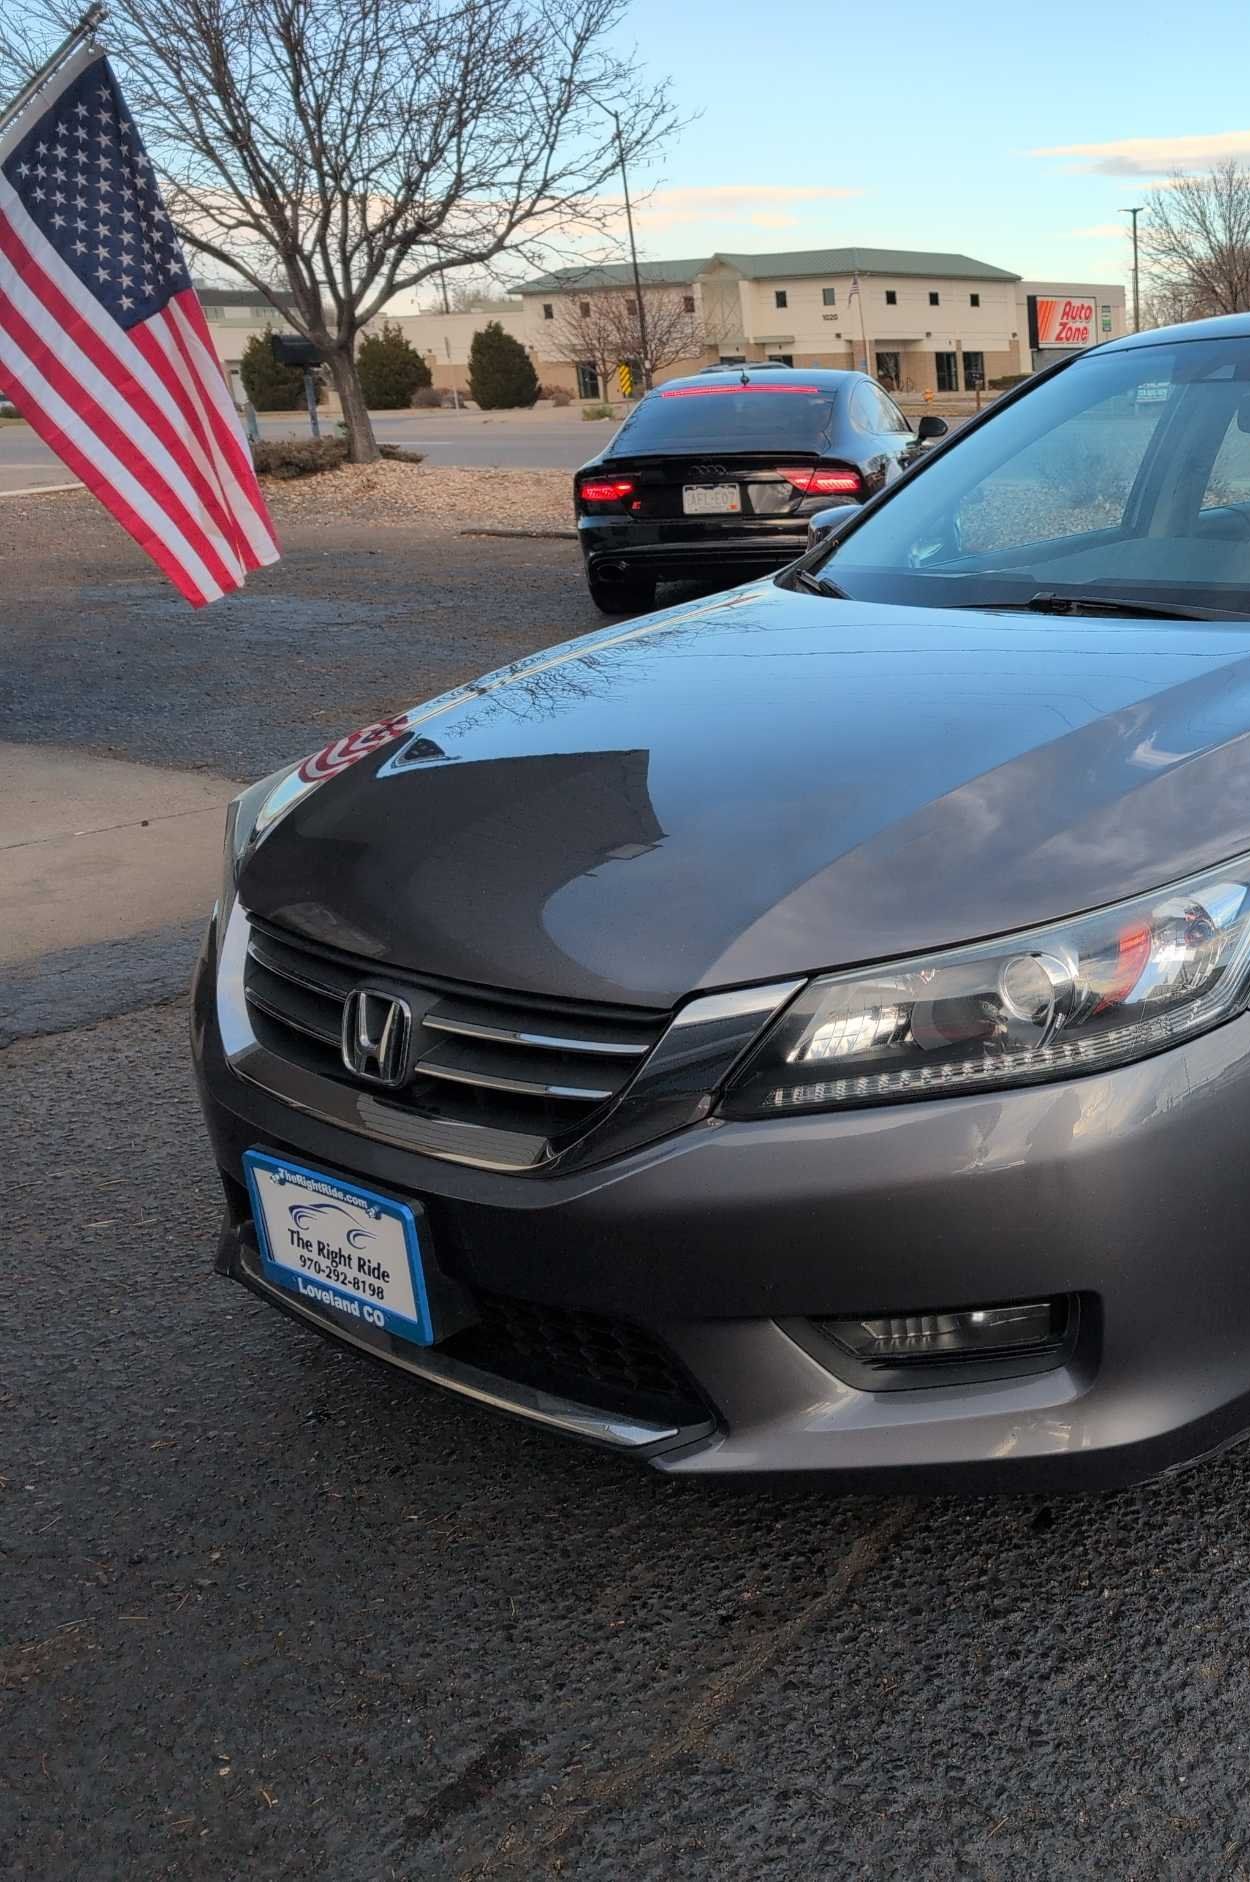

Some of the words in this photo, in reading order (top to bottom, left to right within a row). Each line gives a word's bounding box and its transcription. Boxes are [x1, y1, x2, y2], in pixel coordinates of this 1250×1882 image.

[1055, 321, 1089, 342] Zone
[1061, 300, 1093, 321] Auto
[287, 1228, 313, 1253] The
[317, 1240, 353, 1269] Right
[357, 1255, 391, 1284] Ride
[299, 1254, 385, 1301] 970-292-8198
[296, 1277, 361, 1318] Loveland
[363, 1304, 386, 1328] CO
